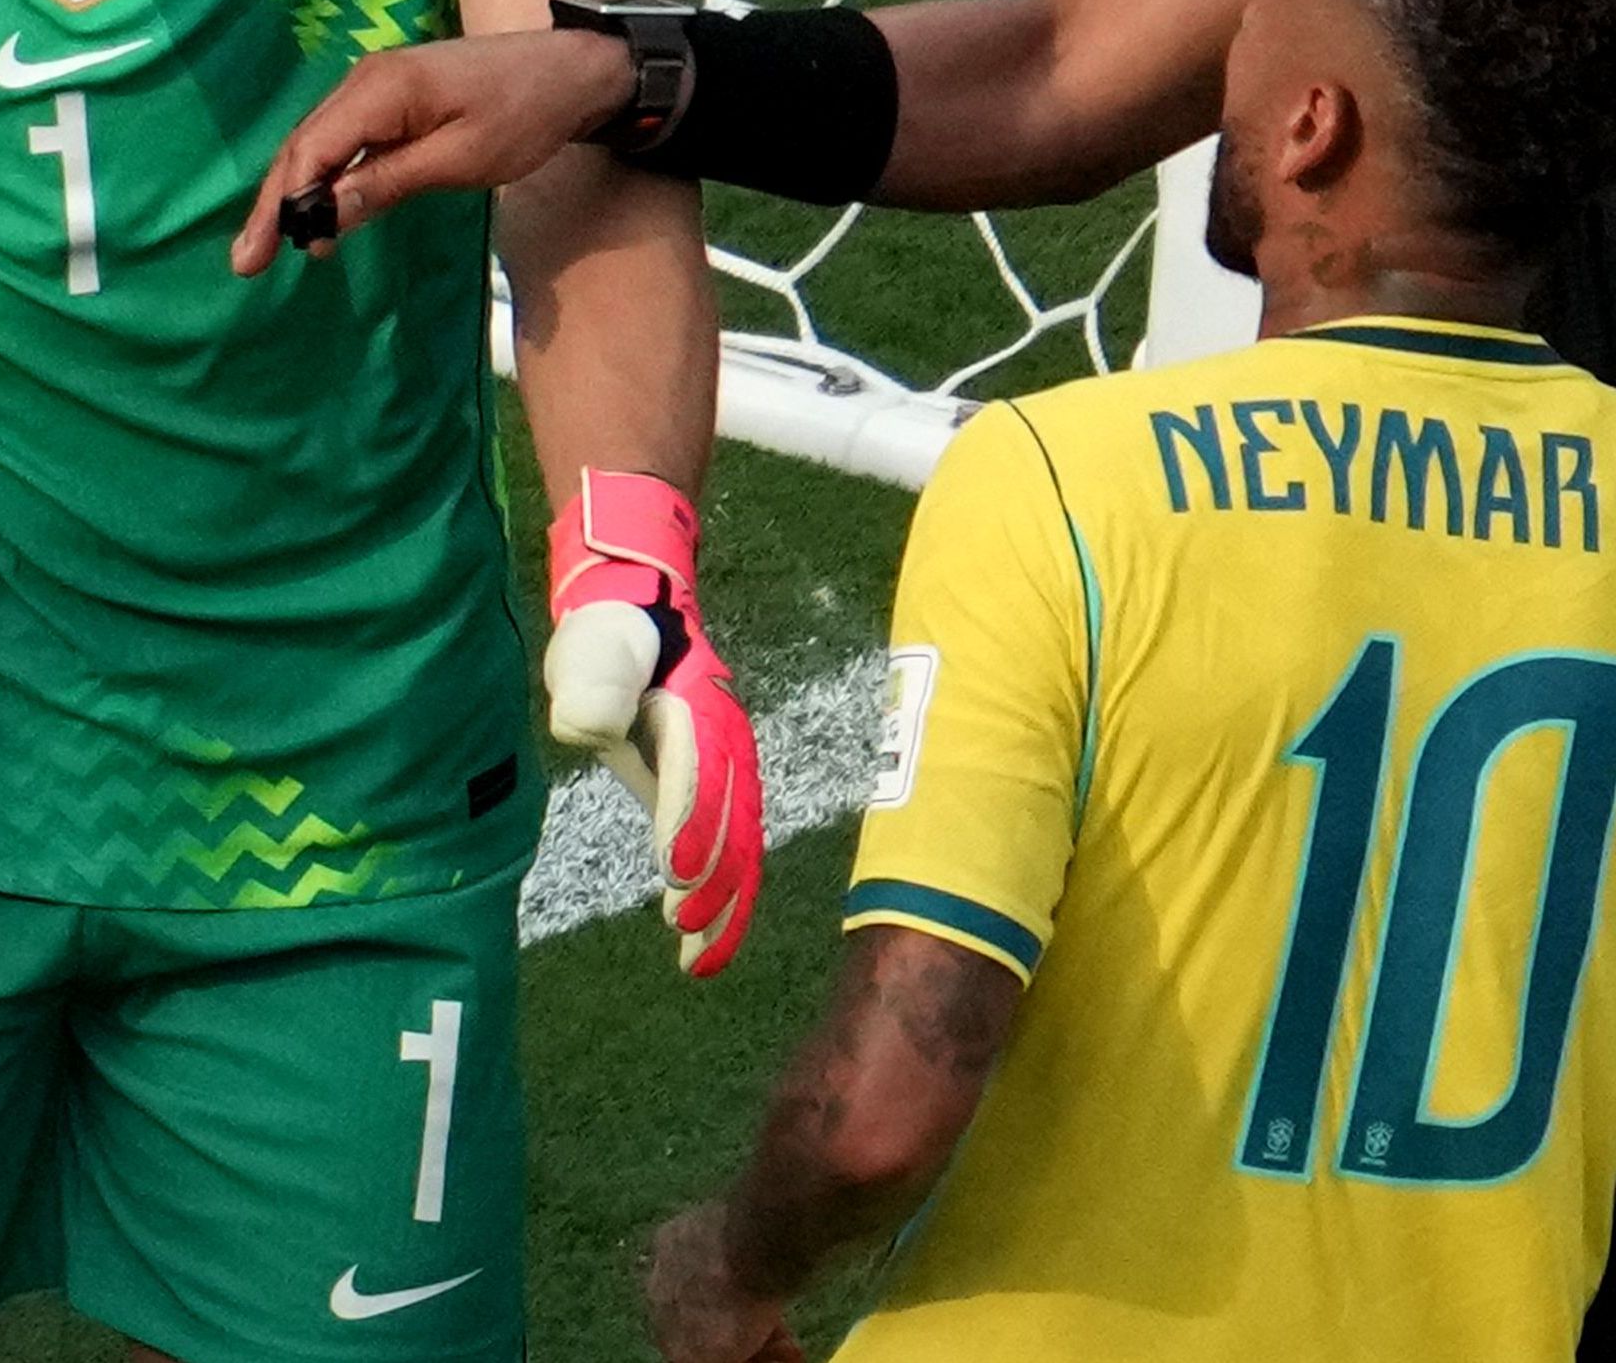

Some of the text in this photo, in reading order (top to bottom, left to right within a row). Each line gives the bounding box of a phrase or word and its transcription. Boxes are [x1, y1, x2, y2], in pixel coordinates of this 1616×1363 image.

[28, 91, 101, 296] 1
[1149, 399, 1600, 553] NEYMAR
[399, 999, 463, 1223] 1
